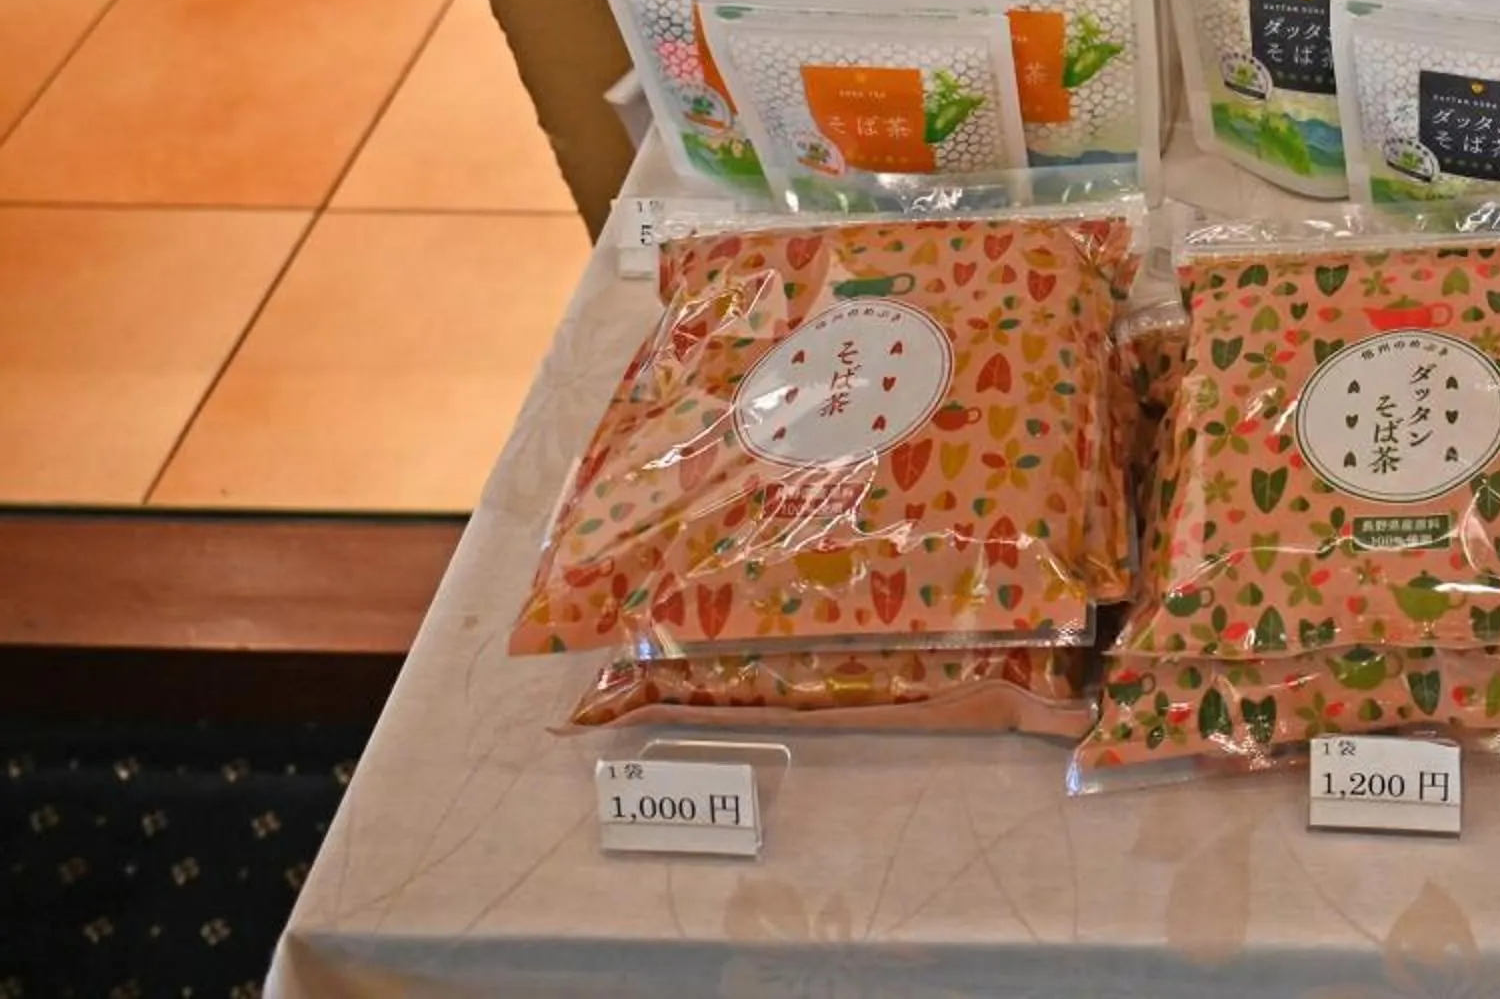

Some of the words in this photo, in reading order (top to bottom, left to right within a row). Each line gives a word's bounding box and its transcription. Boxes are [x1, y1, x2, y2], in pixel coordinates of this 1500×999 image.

[1263, 17, 1332, 41] ダッタ
[818, 340, 863, 417] そば茶
[1408, 362, 1438, 447] ダッタン
[1367, 394, 1405, 475] そば茶
